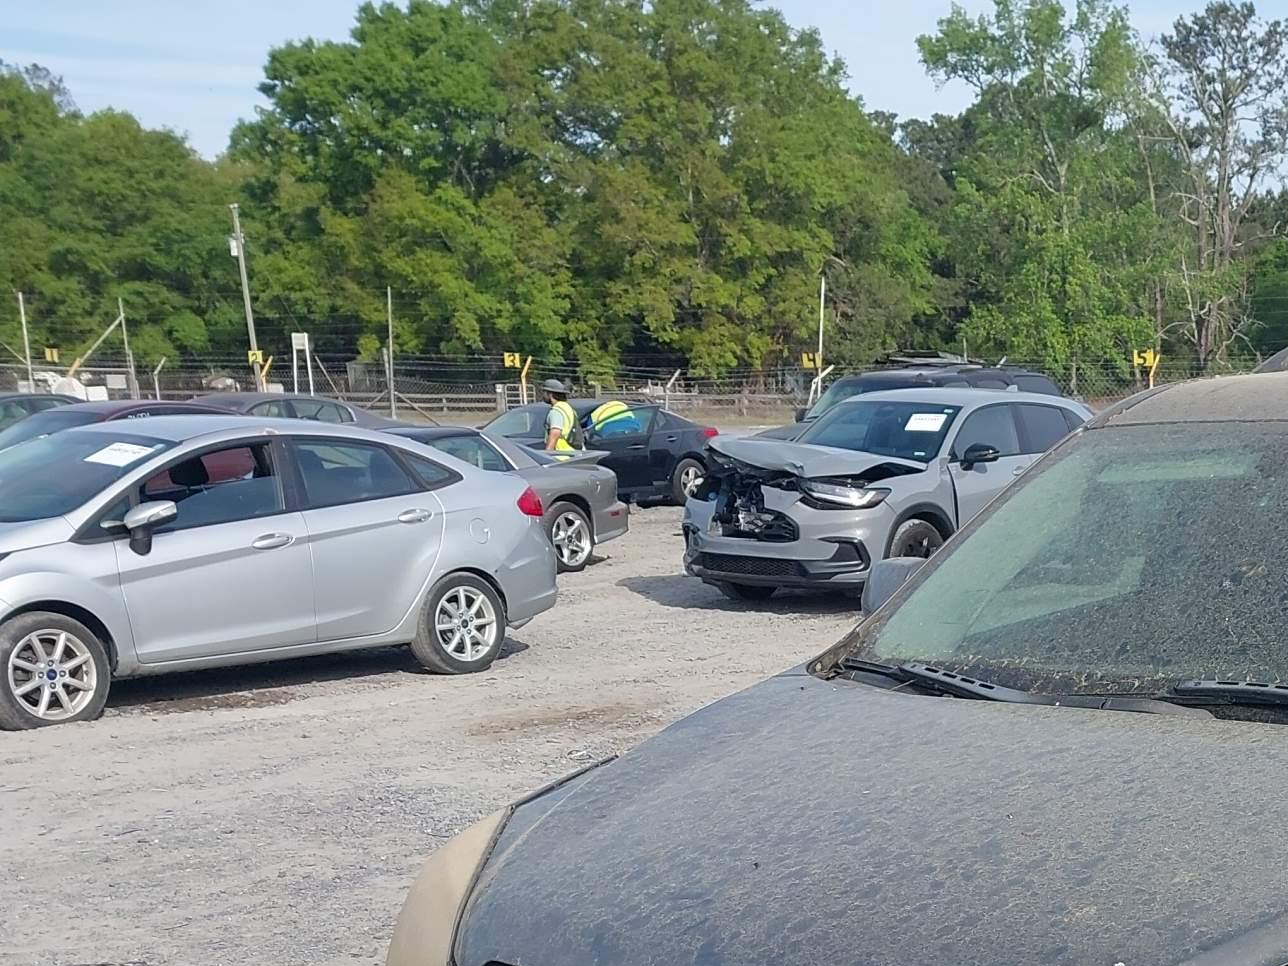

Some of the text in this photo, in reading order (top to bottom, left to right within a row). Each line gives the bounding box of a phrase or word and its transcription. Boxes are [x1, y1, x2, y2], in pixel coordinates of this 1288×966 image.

[507, 353, 516, 368] 3
[806, 352, 817, 368] 4
[1137, 351, 1147, 366] 5
